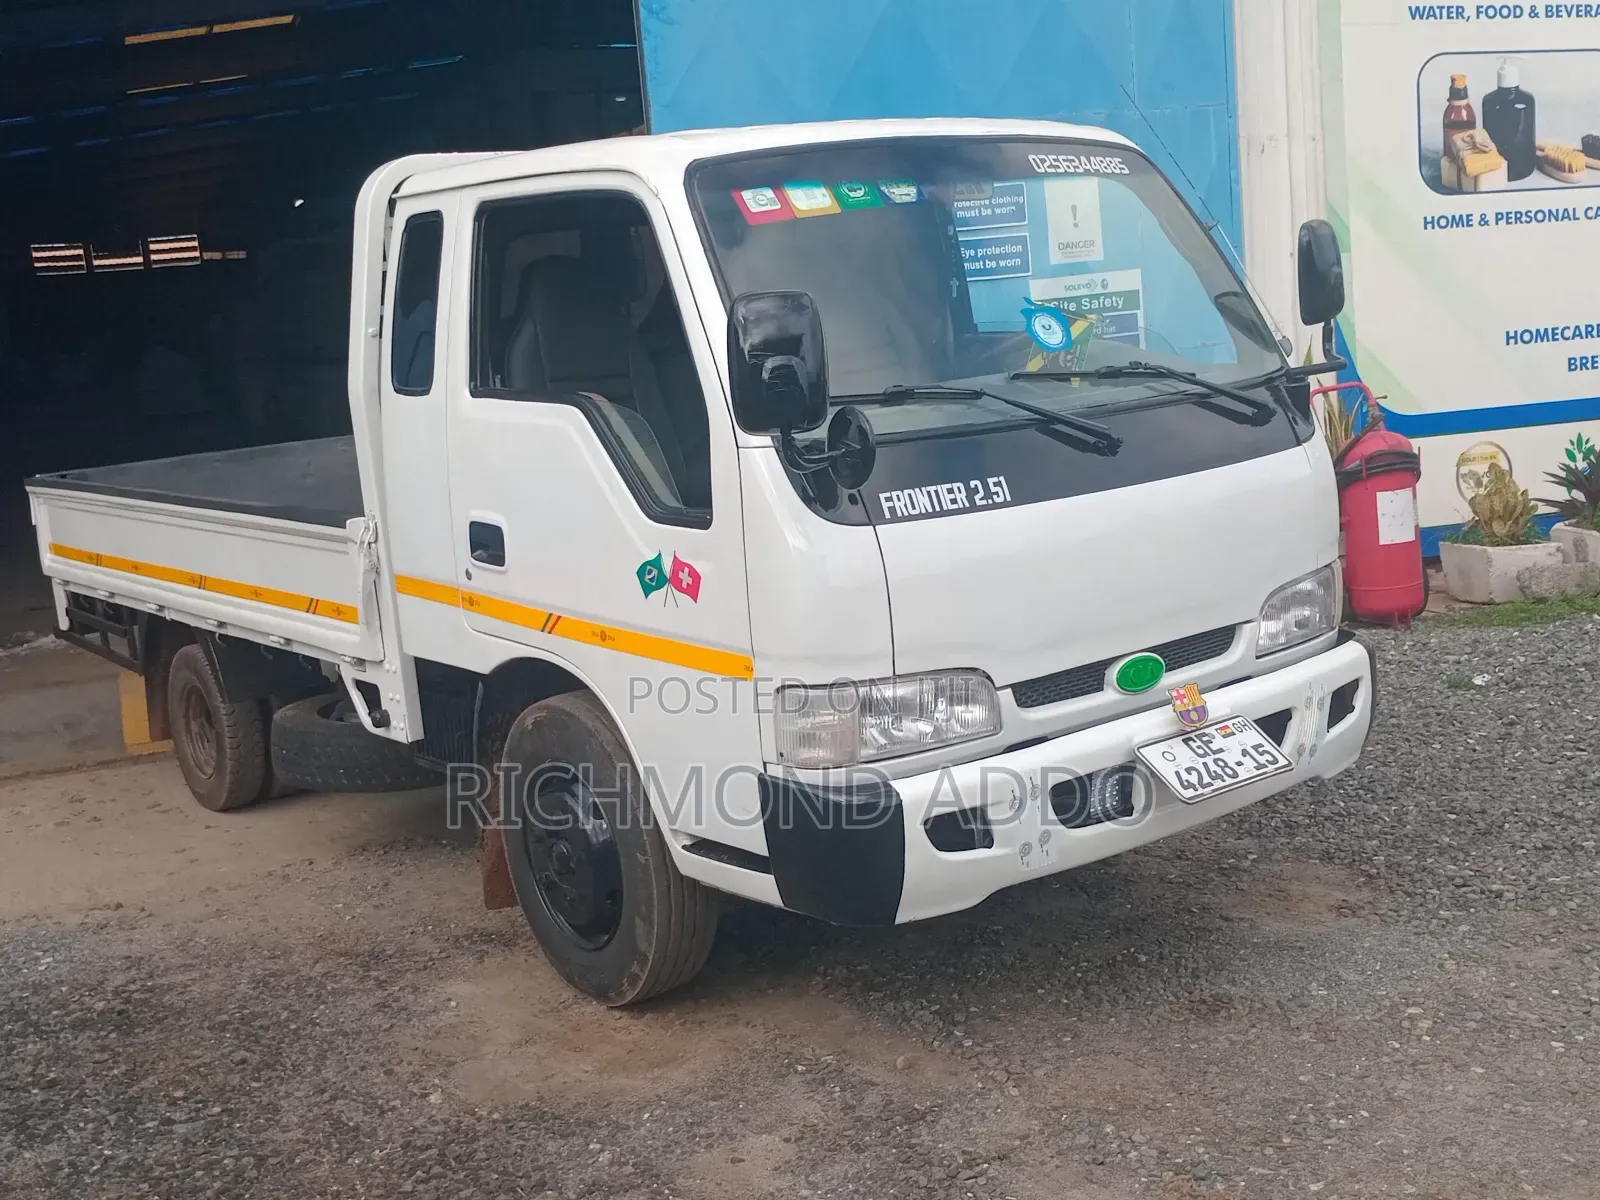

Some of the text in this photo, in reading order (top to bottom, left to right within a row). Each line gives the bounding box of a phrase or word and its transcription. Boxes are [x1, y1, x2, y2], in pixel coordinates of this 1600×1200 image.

[1408, 5, 1471, 22] WATER,
[1476, 4, 1524, 20] FOOD
[1528, 4, 1540, 19] &
[1028, 154, 1130, 174] 0256344885
[953, 195, 1024, 209] rotective clothing
[956, 206, 1016, 218] must be worn
[1423, 213, 1474, 231] HOME
[1478, 212, 1490, 227] &
[1495, 207, 1580, 226] PERSONAL
[977, 244, 1023, 257] protection
[1057, 239, 1096, 252] DANGER
[985, 259, 997, 269] be
[998, 258, 1021, 267] worn
[1081, 295, 1124, 310] Safety
[1567, 354, 1600, 373] BRE
[878, 481, 970, 519] FRONTIER
[1181, 719, 1252, 759] GE GH
[1174, 742, 1280, 792] 4248-15
